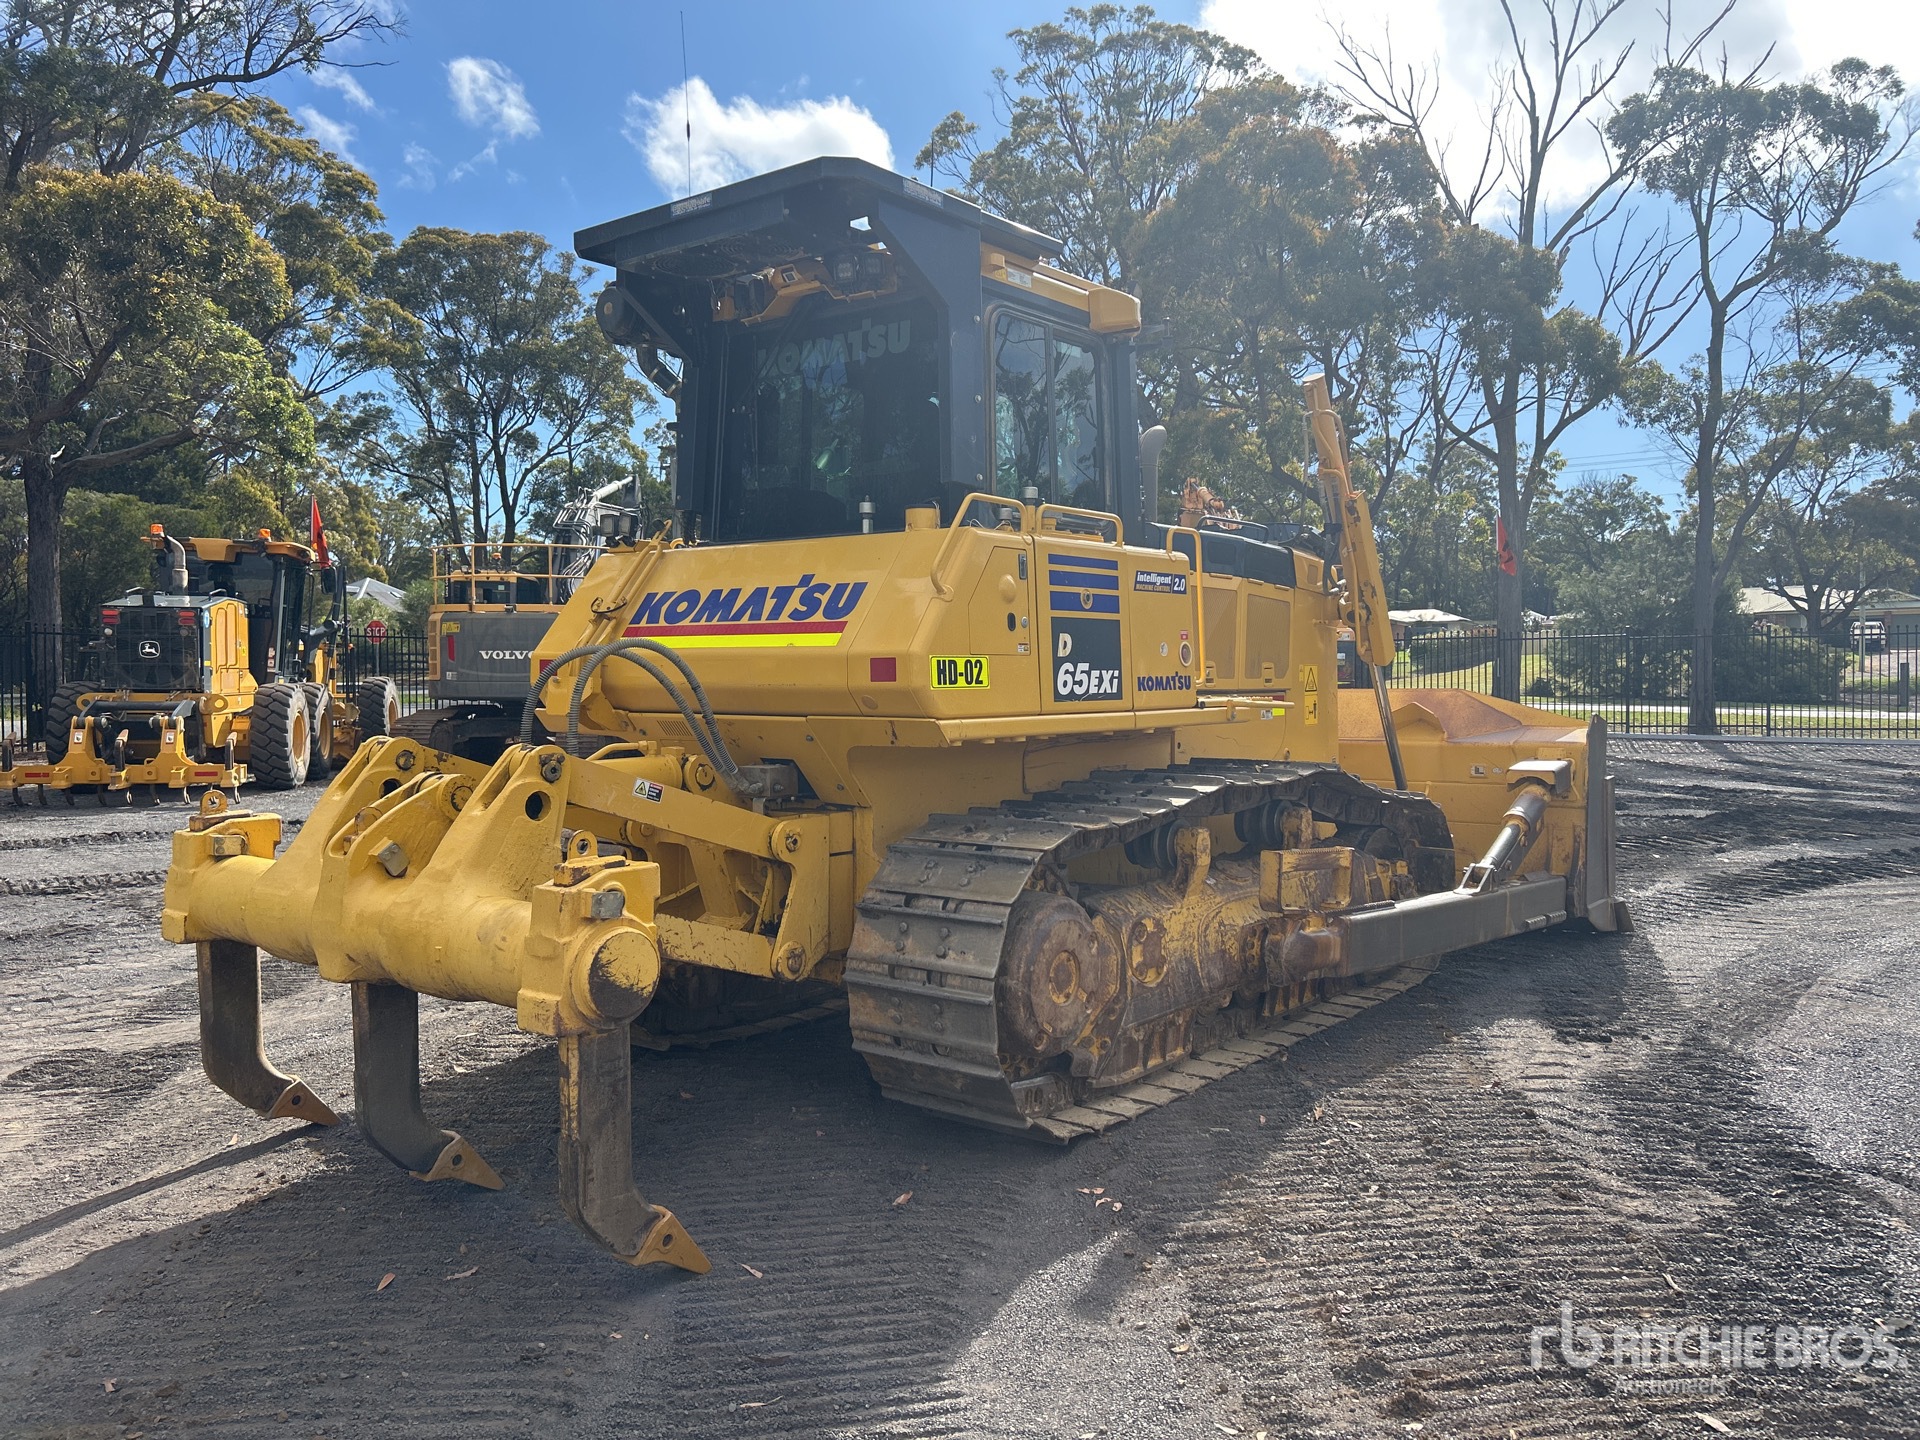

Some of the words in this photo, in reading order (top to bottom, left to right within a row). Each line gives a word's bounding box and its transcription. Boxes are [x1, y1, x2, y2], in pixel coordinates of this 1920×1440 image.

[758, 318, 911, 379] KOMATSU
[1137, 572, 1172, 586] intelligent
[1173, 577, 1186, 592] 2.0
[630, 574, 868, 625] KOMATSU
[1057, 633, 1072, 658] D
[936, 658, 984, 686] HD-02
[1137, 671, 1191, 692] KOMATSU
